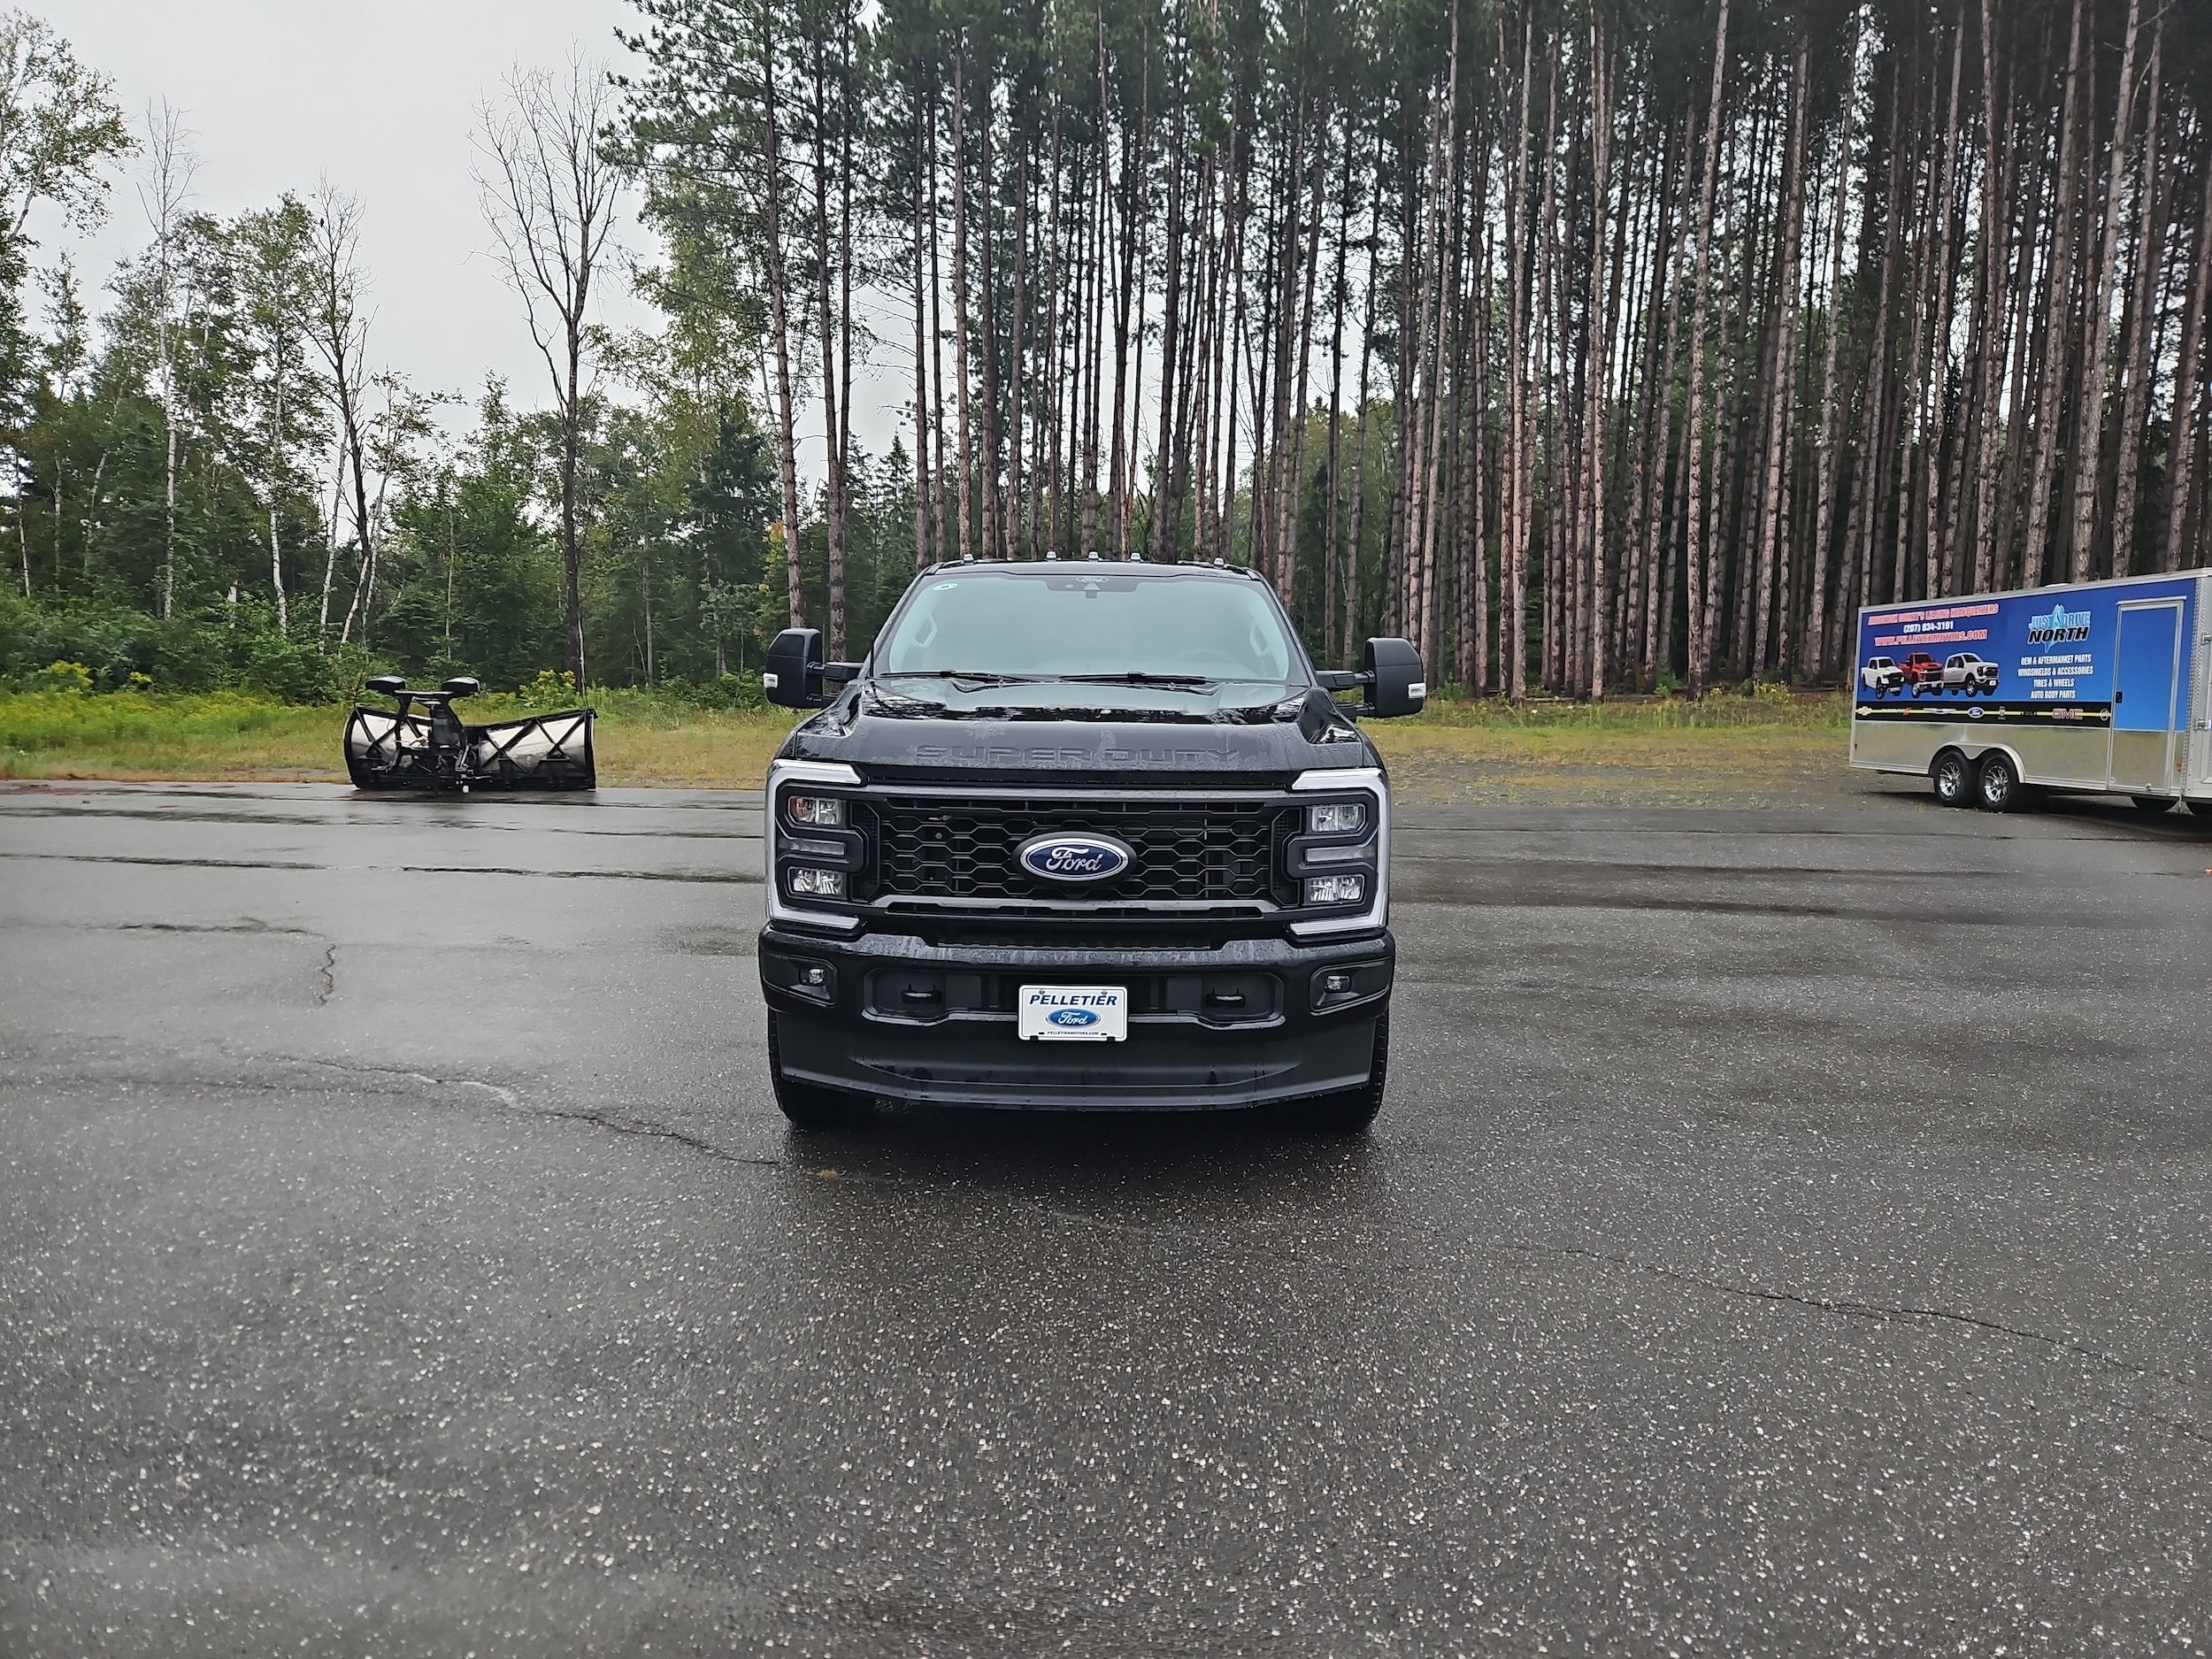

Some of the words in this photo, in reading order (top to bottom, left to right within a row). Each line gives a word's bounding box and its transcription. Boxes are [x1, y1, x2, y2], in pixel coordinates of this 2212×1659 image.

[1949, 603, 1999, 618] HEADQUARTERS
[2062, 611, 2091, 627] DRIVE
[1903, 624, 1920, 634] (207)
[2027, 626, 2090, 645] NORTH
[2021, 657, 2032, 665] OEM
[2038, 655, 2074, 665] AFTERMARKET
[2074, 654, 2092, 663] PARTS
[2017, 667, 2051, 677] WINDSHIELDS
[2052, 667, 2056, 676] &
[2057, 665, 2093, 675] ACCESSORIES
[2033, 679, 2047, 687] TIRES
[2053, 678, 2075, 687] WHEELS
[2030, 690, 2044, 699] AUTO
[2045, 690, 2058, 699] BODY
[2059, 689, 2076, 698] PARTS
[2052, 708, 2084, 719] GMC
[915, 745, 1092, 767] SUPER
[1104, 748, 1240, 769] DUTY
[1046, 847, 1104, 872] Ford
[1029, 995, 1118, 1006] PELLETIER
[1057, 1011, 1088, 1025] Ford
